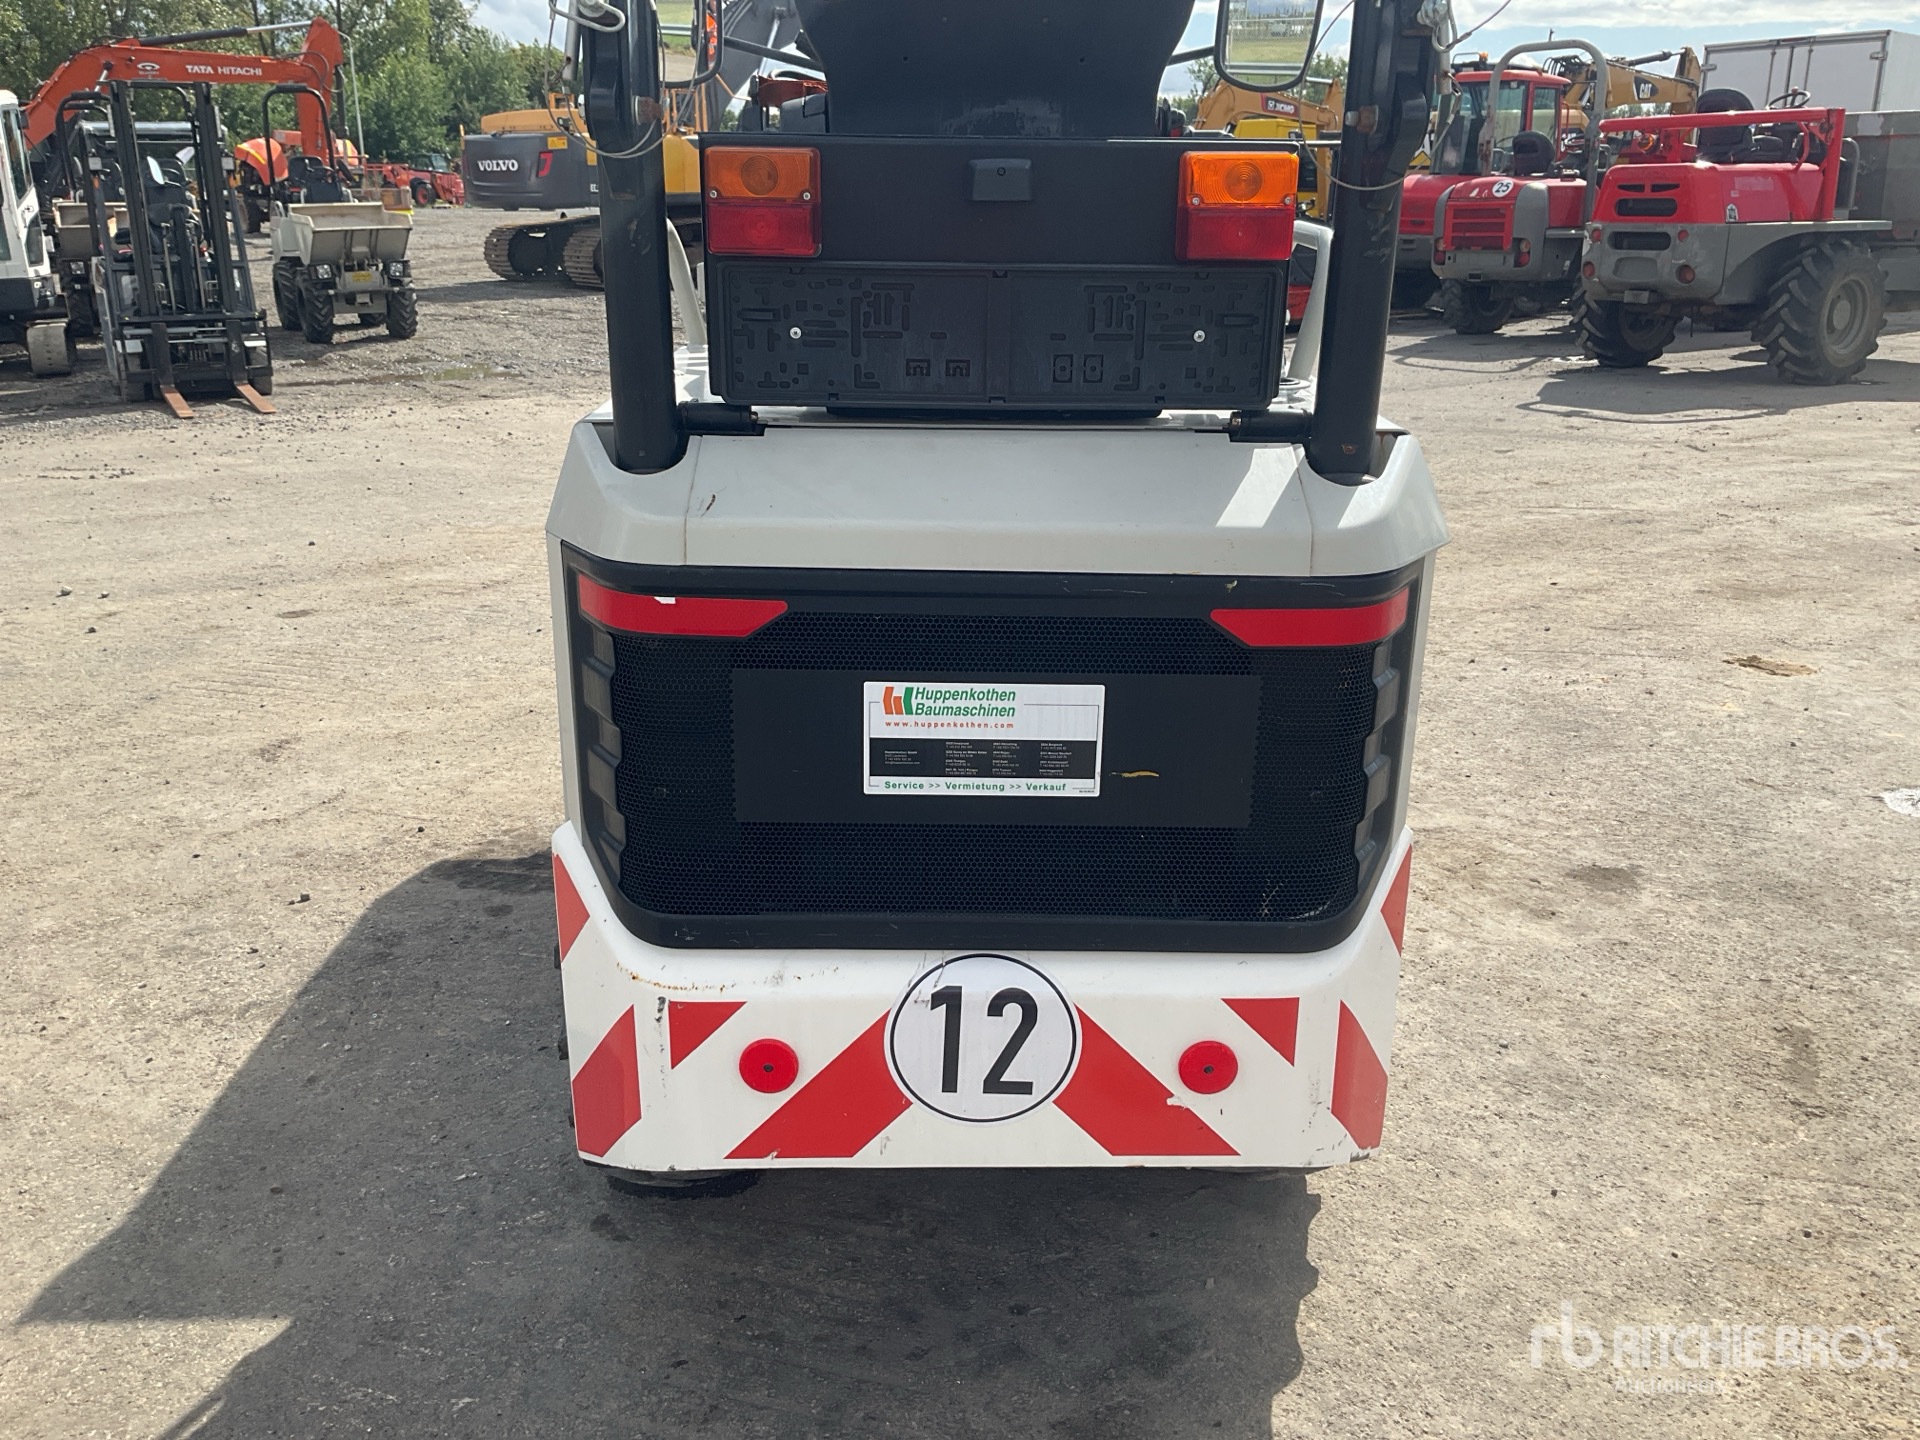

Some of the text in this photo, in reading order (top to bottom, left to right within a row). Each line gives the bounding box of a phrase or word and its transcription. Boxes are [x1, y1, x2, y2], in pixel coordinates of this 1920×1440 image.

[185, 65, 262, 76] TATA HITACHI
[1639, 83, 1653, 99] CAT
[477, 159, 519, 171] VOLVO
[1494, 182, 1511, 193] 25
[914, 687, 1016, 703] Huppenkothen
[914, 703, 1016, 717] Baumaschinen
[884, 781, 925, 790] Service
[945, 782, 1005, 792] Vermietung
[1026, 783, 1067, 791] Verkauf
[930, 985, 1038, 1095] 12
